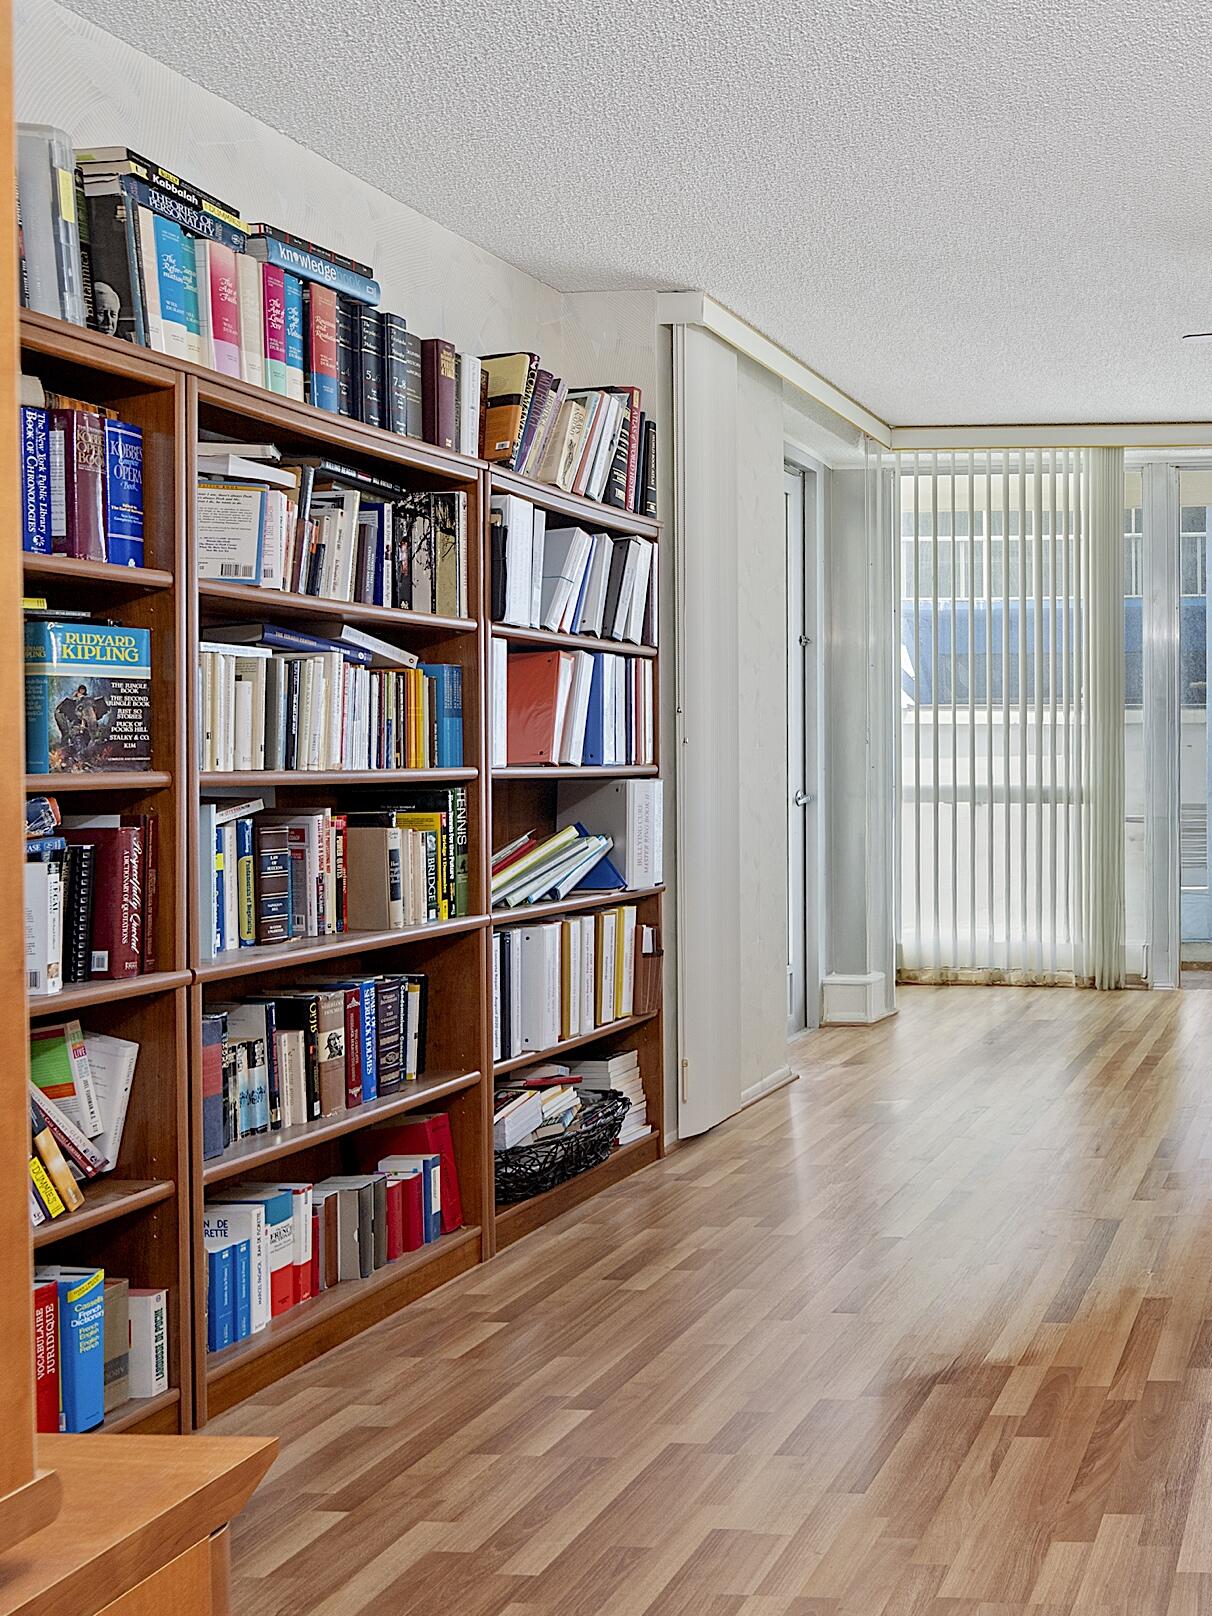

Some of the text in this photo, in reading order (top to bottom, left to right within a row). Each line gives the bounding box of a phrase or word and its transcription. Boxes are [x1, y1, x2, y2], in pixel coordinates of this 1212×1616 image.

[152, 174, 198, 205] Kabbalah
[148, 189, 198, 221] THEORIES
[200, 215, 214, 227] OF
[149, 197, 215, 236] PERSONALITY
[365, 370, 372, 380] 5
[393, 377, 399, 386] 7
[25, 410, 37, 533] BOOK OF CHRONOLOGIES
[37, 413, 48, 534] The New York Public Library
[65, 632, 135, 647] RUDYARD
[61, 645, 139, 662] KIPLING
[124, 682, 148, 690] JUNGLE
[123, 695, 149, 703] SECOND
[456, 788, 467, 845] TENNIS
[427, 856, 436, 902] BRIDGE
[73, 1048, 87, 1058] LIVE
[365, 1035, 373, 1075] HOLMES
[32, 1165, 57, 1205] DUMMIES
[217, 1220, 229, 1229] DE
[70, 1309, 104, 1328] Dictionary
[79, 1305, 101, 1319] French
[154, 1307, 163, 1332] POCHE
[45, 1303, 55, 1375] JURIDIQUE
[79, 1323, 99, 1334] French
[79, 1328, 99, 1341] English
[36, 1308, 46, 1381] VOCABULAIRE
[79, 1336, 99, 1348] English
[155, 1343, 165, 1381] LAROUSSE
